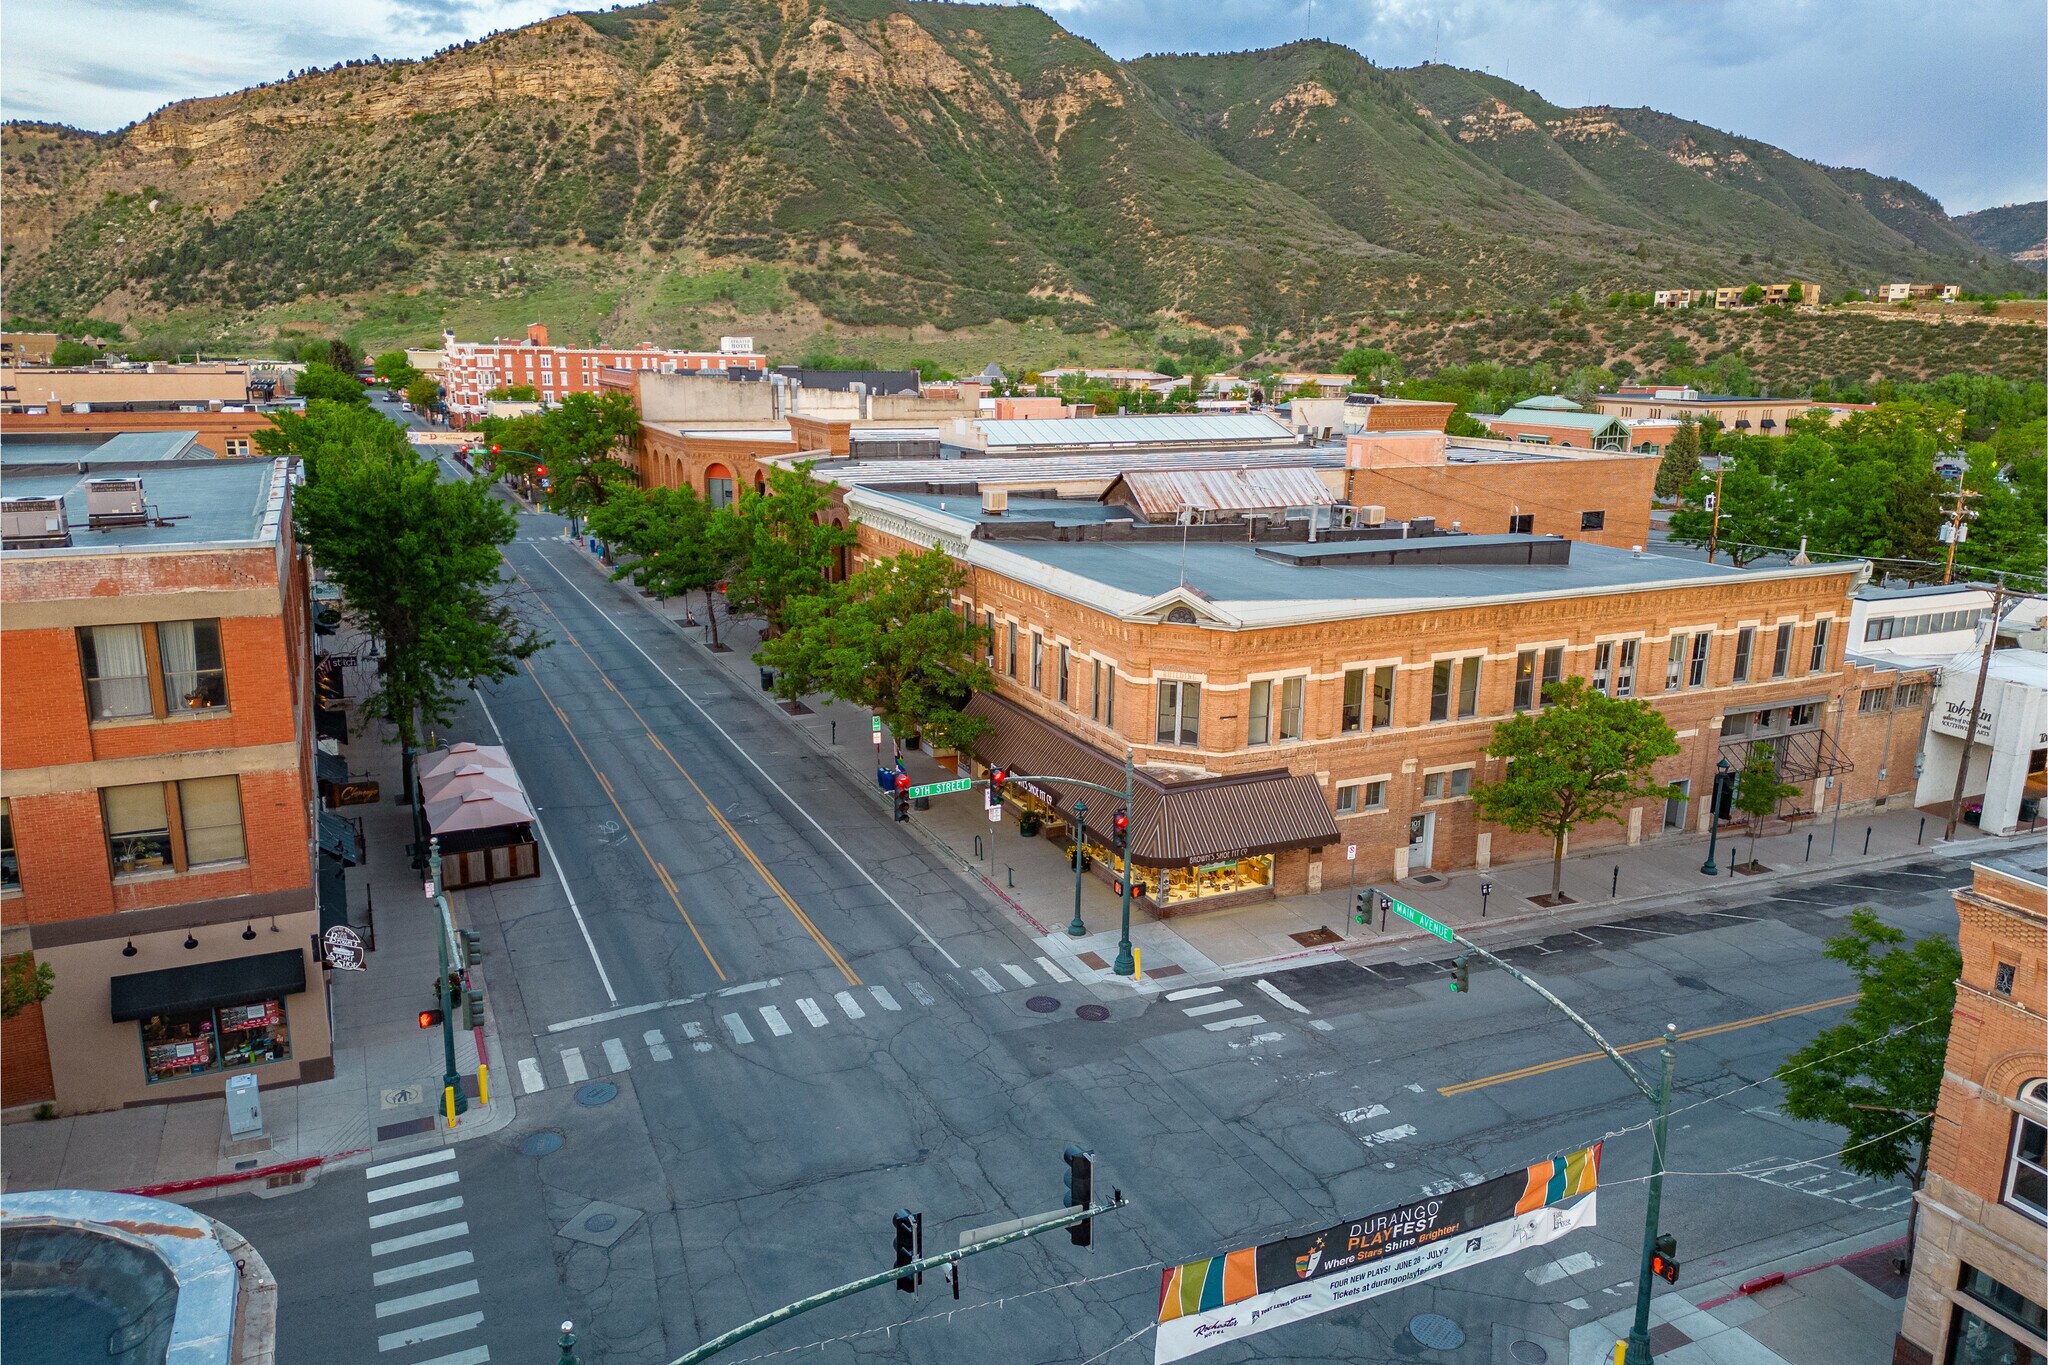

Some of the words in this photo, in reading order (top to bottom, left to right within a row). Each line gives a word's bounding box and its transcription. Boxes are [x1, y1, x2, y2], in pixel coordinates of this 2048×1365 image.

[332, 657, 356, 667] sttch
[914, 787, 930, 796] 9TH
[936, 780, 966, 793] STREET
[1027, 782, 1039, 798] SHOE
[1189, 853, 1215, 865] BROWN'S
[1216, 851, 1231, 860] SHOE
[1231, 849, 1240, 858] FIT
[1396, 903, 1415, 921] MAIN
[1420, 915, 1449, 939] AVENUE
[1350, 1201, 1440, 1238] DURANGO
[1348, 1215, 1438, 1251] PLAYFEST
[1324, 1255, 1356, 1270] Where
[1357, 1247, 1383, 1261] Stars
[1385, 1237, 1416, 1253] Shine
[1418, 1223, 1460, 1243] Brighter!
[1330, 1278, 1349, 1290] FOUR
[1350, 1273, 1366, 1284] NEW
[1367, 1265, 1391, 1279] PLAYS!
[1394, 1259, 1413, 1271] JUNE
[1413, 1255, 1421, 1265] 28
[1426, 1249, 1444, 1261] JULY
[1444, 1247, 1449, 1255] 2
[1332, 1287, 1360, 1301] Tickets
[1361, 1283, 1370, 1293] at
[1371, 1261, 1443, 1289] durangoplayfest.org
[1273, 1300, 1290, 1309] LEWIS
[1290, 1293, 1312, 1304] COLLEGE
[1193, 1316, 1239, 1338] Rochester
[1203, 1329, 1225, 1339] HOTEL
